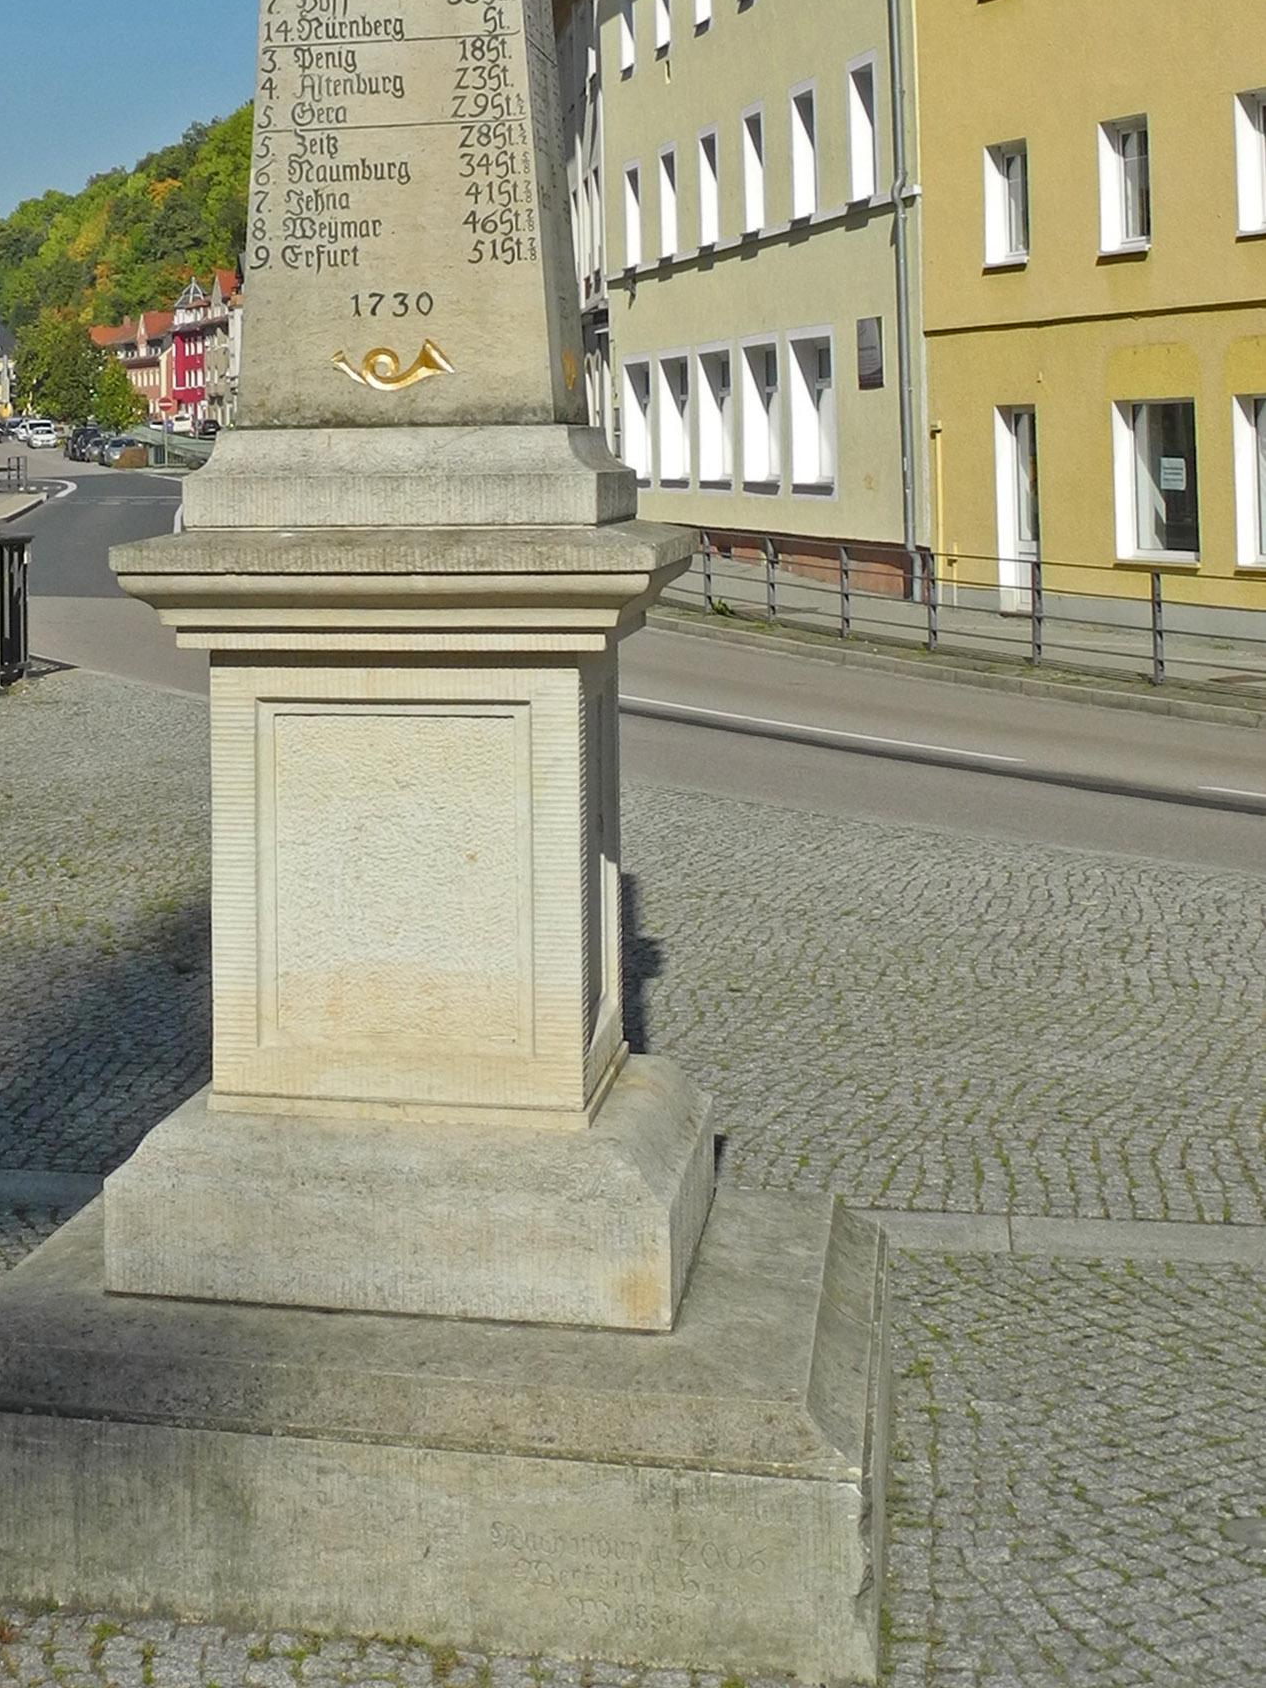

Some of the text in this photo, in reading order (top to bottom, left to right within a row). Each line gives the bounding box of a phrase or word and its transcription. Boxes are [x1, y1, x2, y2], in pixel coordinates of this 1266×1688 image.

[297, 16, 405, 41] Nürnberg
[294, 46, 357, 73] Penig
[293, 74, 405, 102] Altenburg
[291, 102, 348, 126] Gera
[288, 159, 411, 185] Naumburg
[281, 244, 360, 274] Erfurt
[349, 291, 434, 317] 1730
